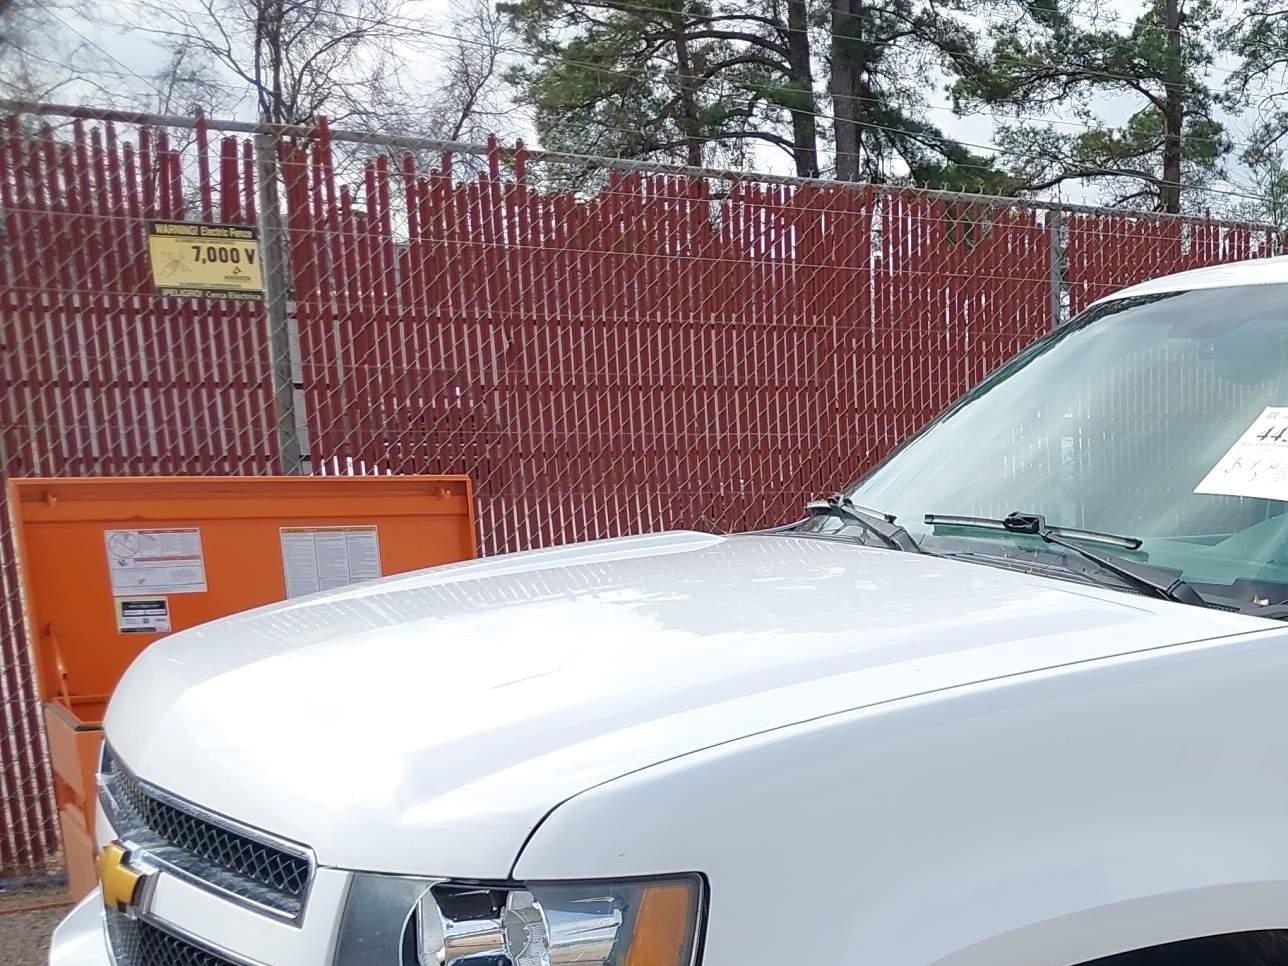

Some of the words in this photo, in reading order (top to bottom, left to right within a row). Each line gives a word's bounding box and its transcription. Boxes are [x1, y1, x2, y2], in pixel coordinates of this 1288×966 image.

[154, 224, 199, 236] WARNING!
[200, 225, 229, 237] Electric
[229, 227, 254, 239] Fence
[192, 245, 241, 264] 7,000
[244, 248, 256, 265] V
